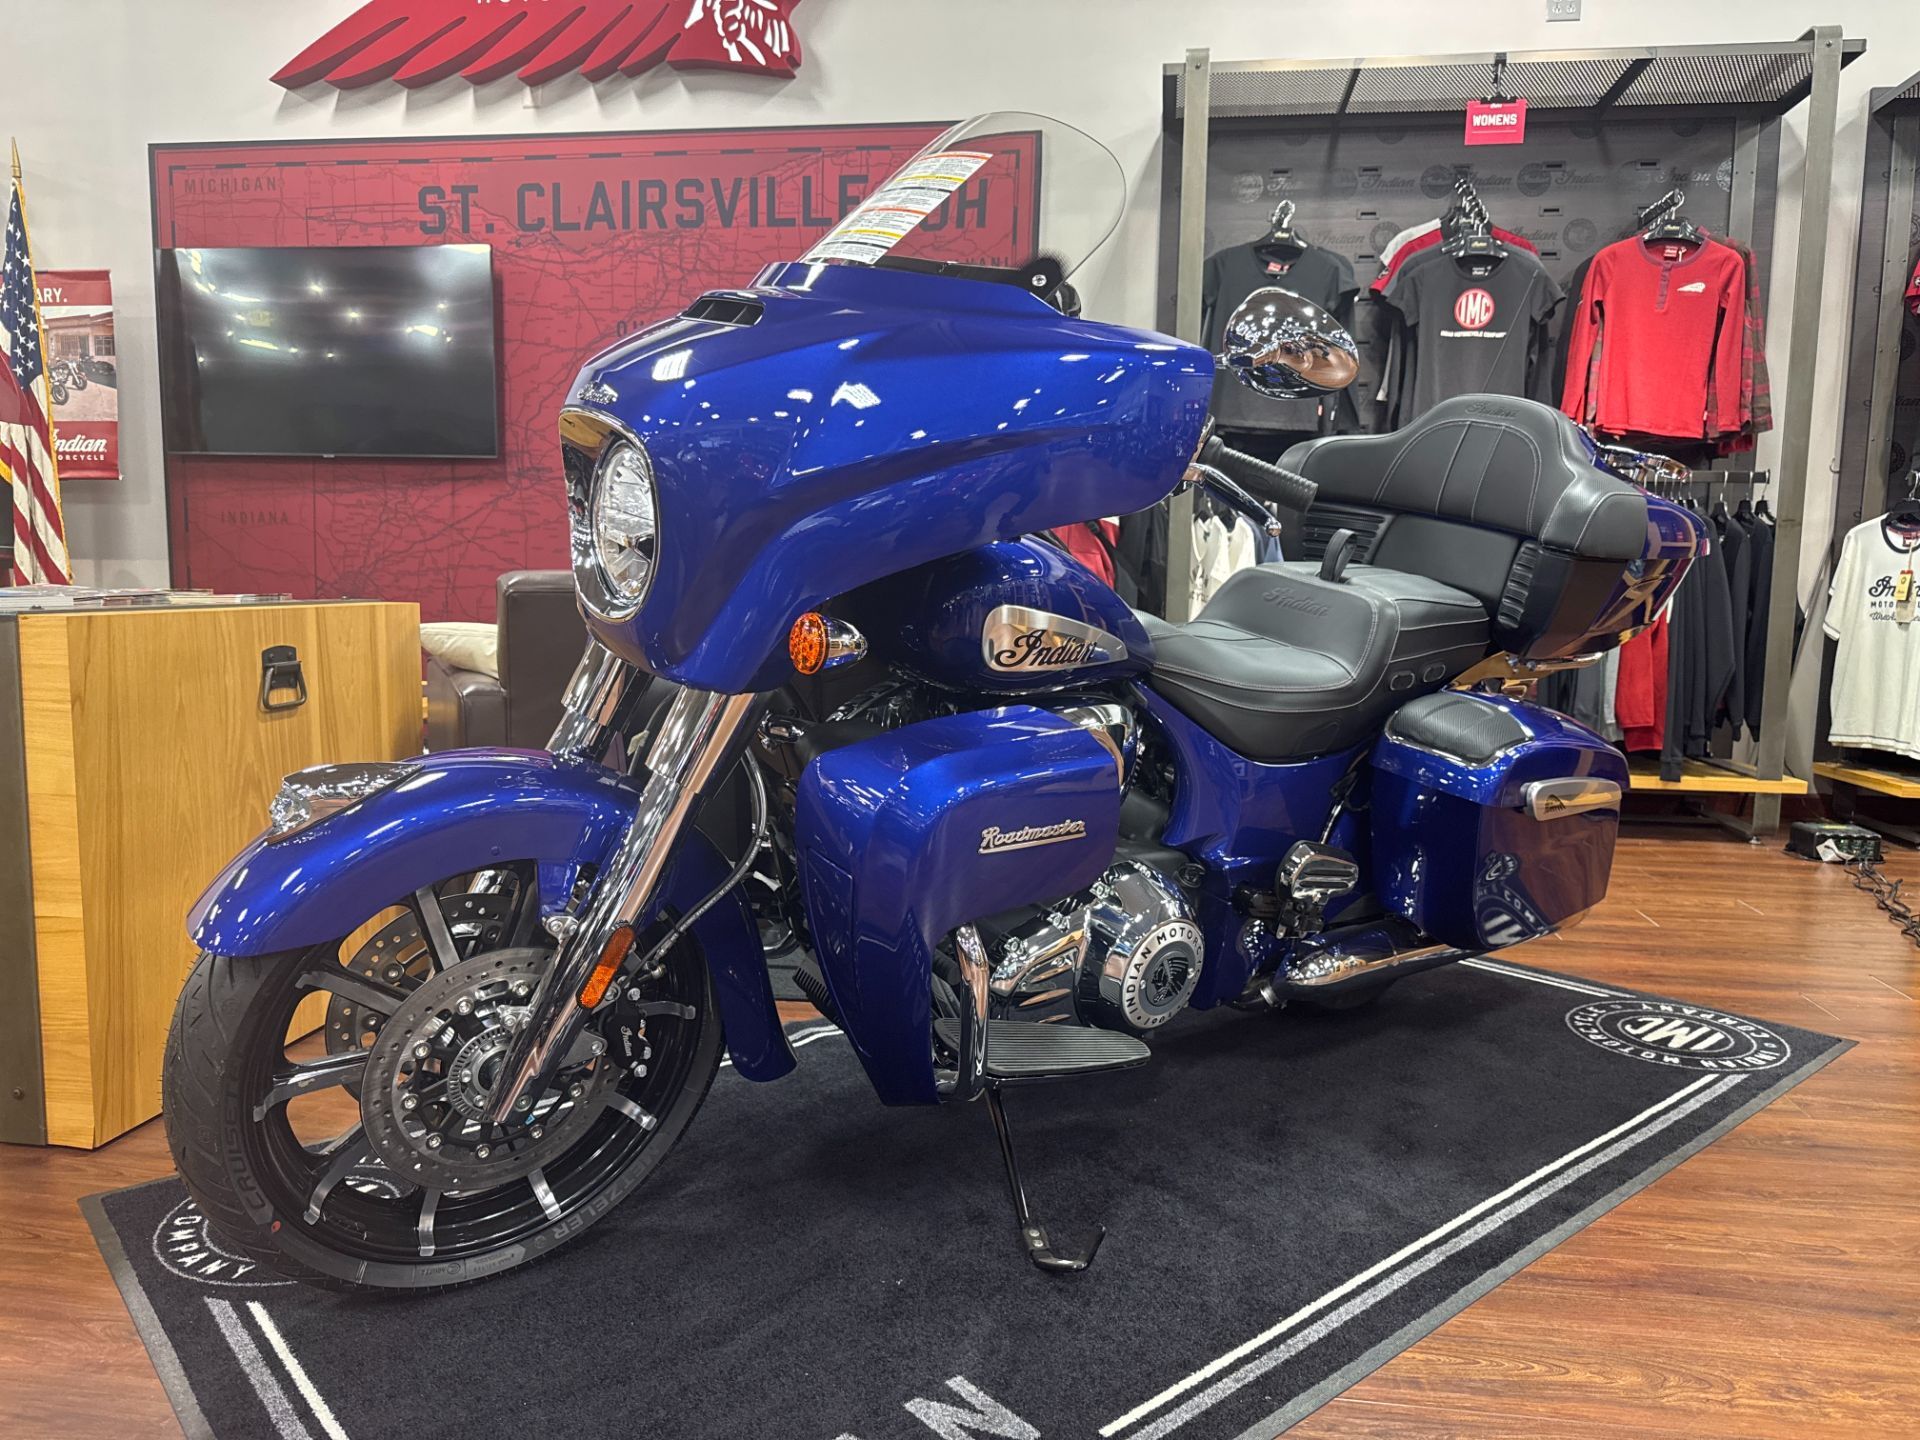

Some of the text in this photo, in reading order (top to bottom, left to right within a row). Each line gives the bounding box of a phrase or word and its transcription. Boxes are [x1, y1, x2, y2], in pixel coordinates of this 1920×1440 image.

[1472, 113, 1518, 127] WOMENS
[184, 177, 277, 193] MICHIGAN
[418, 185, 495, 234] ST.
[517, 174, 869, 231] CLAIRSVILLE
[1459, 292, 1491, 326] IMC
[221, 510, 289, 525] INDIANA
[994, 629, 1098, 668] Indian
[980, 819, 1086, 849] Roadmaster
[1126, 946, 1153, 1015] INDIAN
[1573, 1006, 1782, 1069] INDIAN MOTORCYCLE
[1624, 1017, 1726, 1051] IMC
[1642, 1003, 1771, 1039] COMPANY
[167, 1202, 256, 1279] OMPANY
